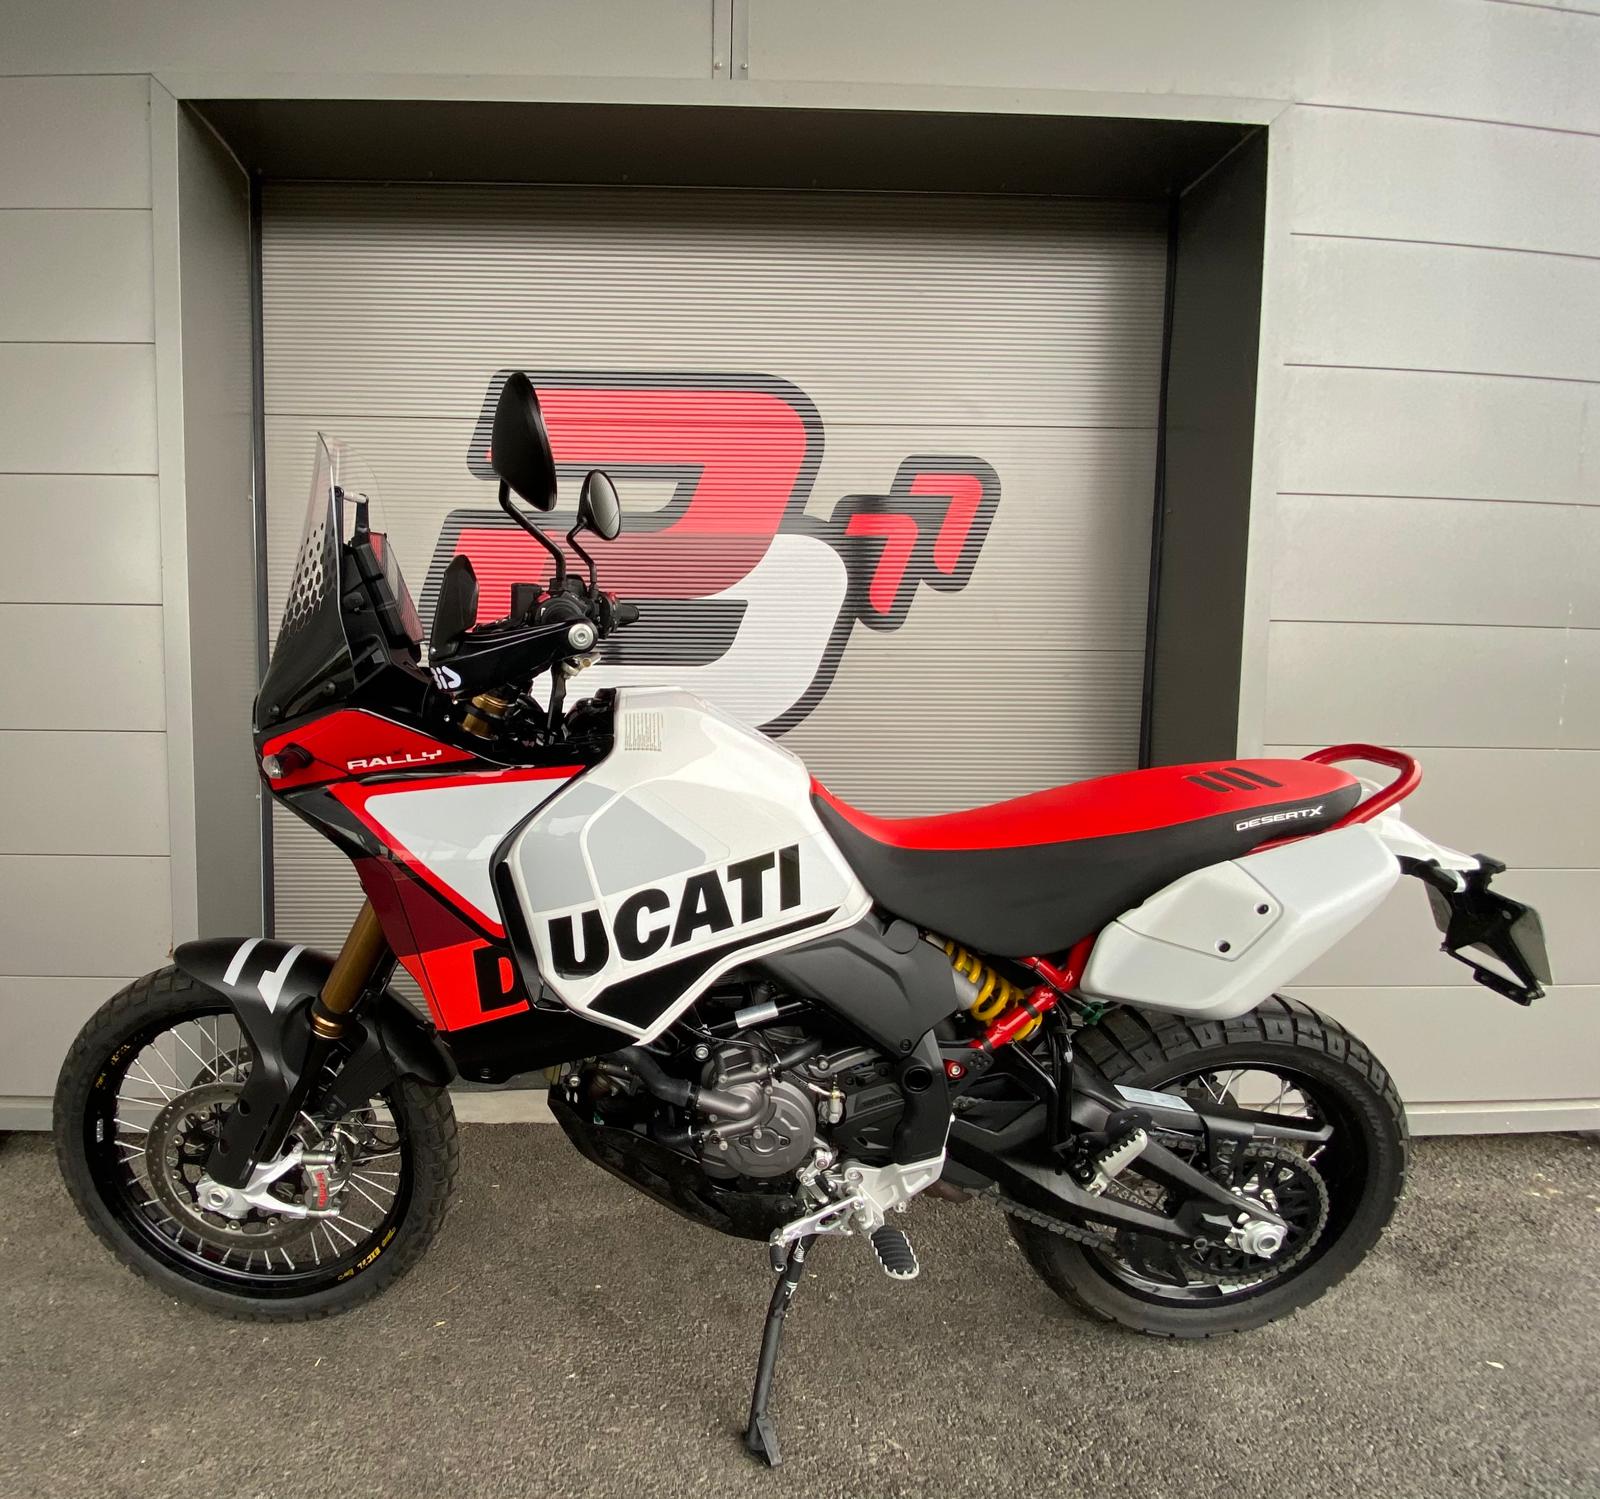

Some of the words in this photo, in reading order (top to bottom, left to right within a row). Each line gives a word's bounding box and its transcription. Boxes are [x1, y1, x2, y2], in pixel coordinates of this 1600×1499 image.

[346, 749, 443, 771] RALLY
[1236, 805, 1323, 832] DESERTX
[473, 843, 801, 1012] DUCATI
